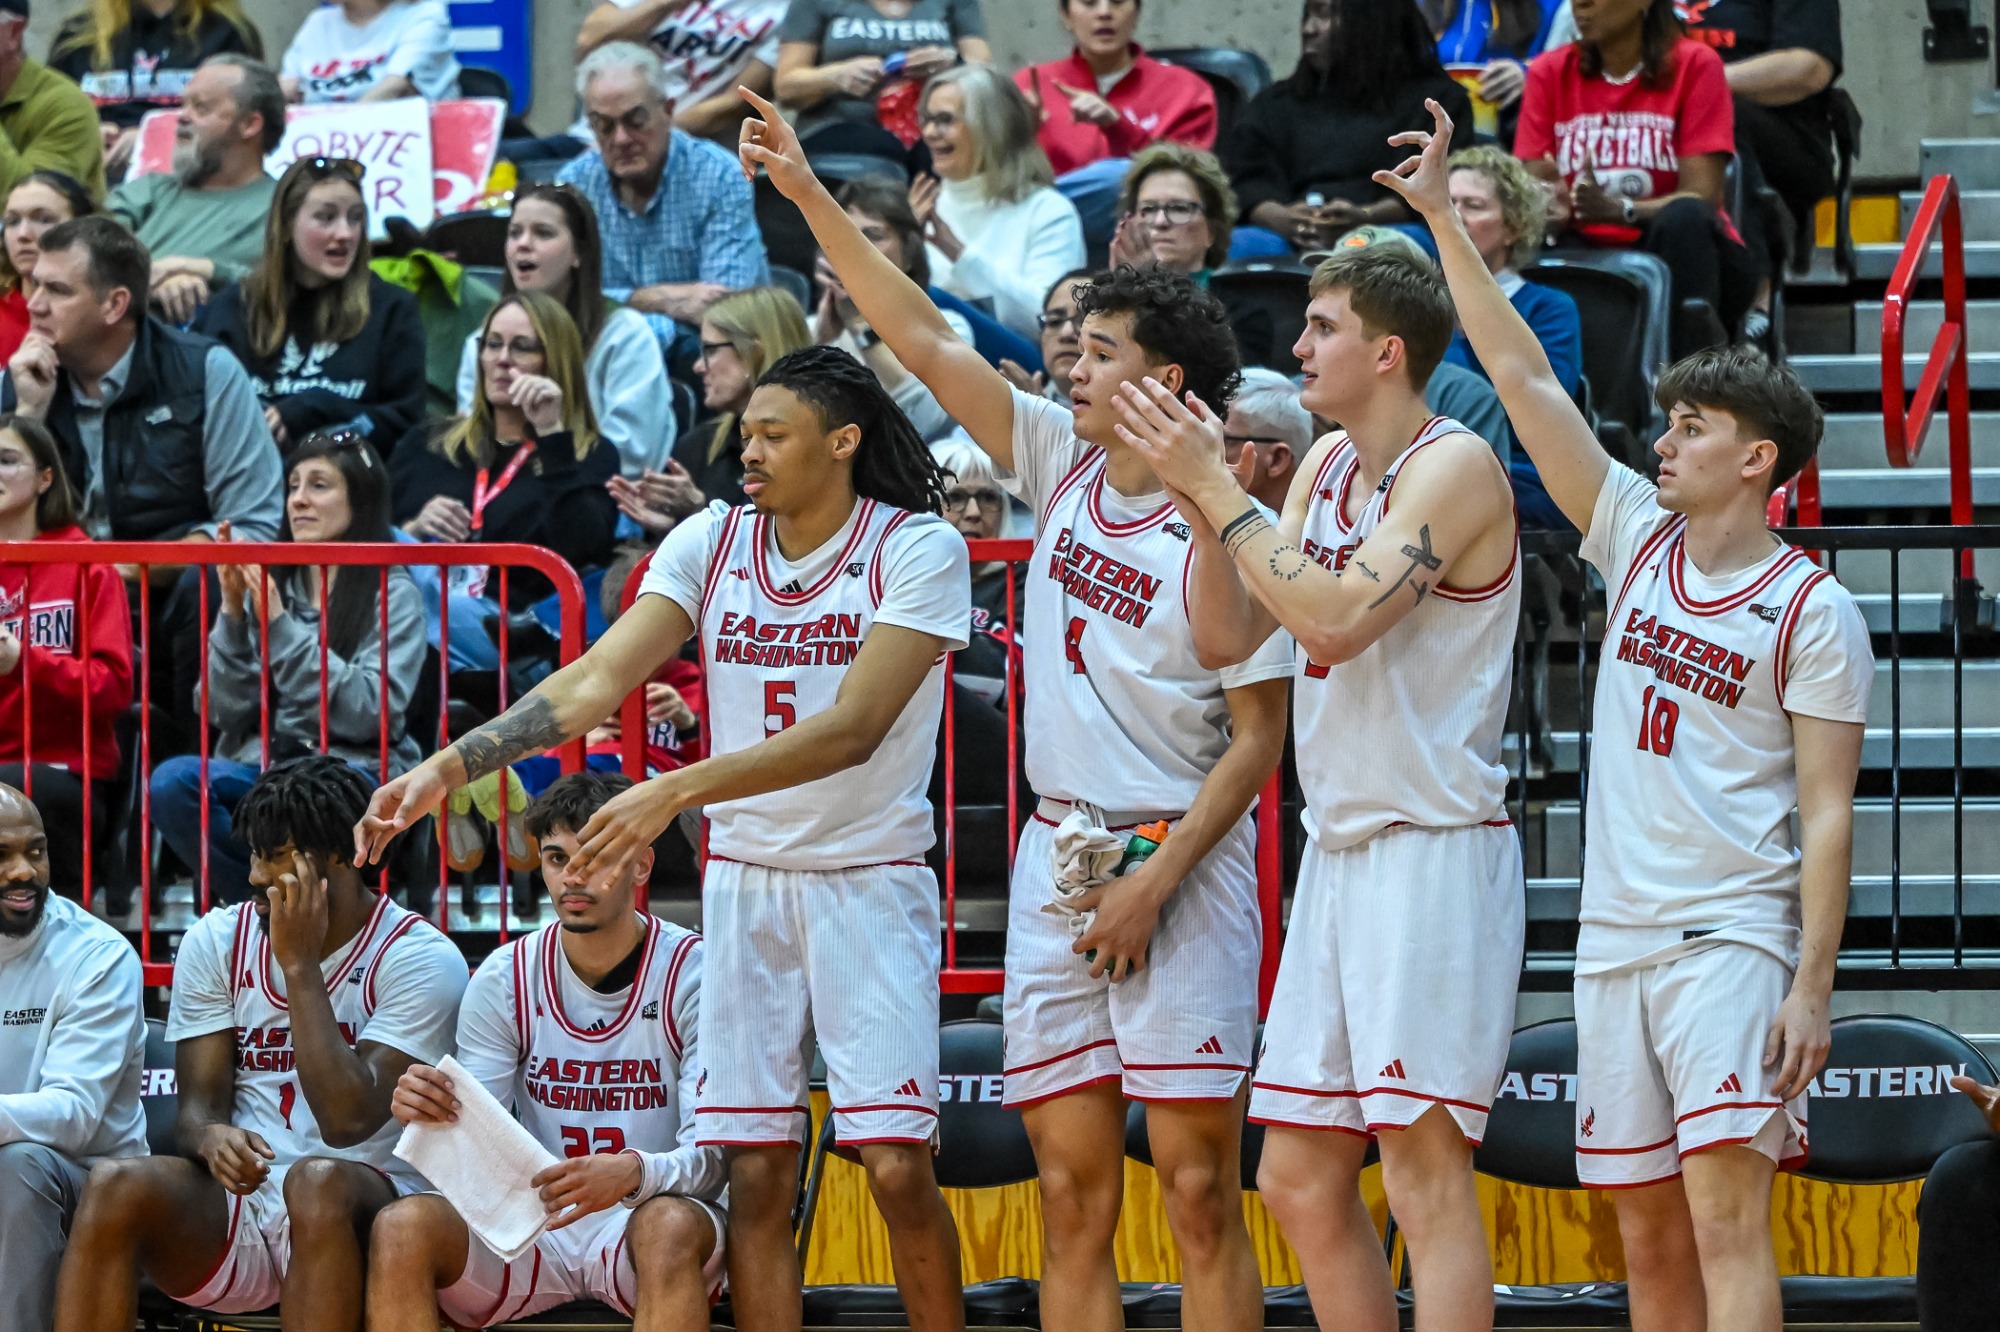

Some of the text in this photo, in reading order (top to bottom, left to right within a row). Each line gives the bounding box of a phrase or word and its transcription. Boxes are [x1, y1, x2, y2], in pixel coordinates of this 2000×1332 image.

[830, 18, 948, 41] EASTERN
[718, 611, 863, 644] EASTERN
[1065, 616, 1088, 675] 4
[1624, 607, 1757, 683] EASTERN
[715, 638, 864, 669] WASHINGTON
[764, 680, 797, 740] 5
[1636, 684, 1680, 759] 10
[528, 1056, 662, 1085] EASTERN
[279, 1081, 296, 1130] 1
[526, 1078, 668, 1112] WASHINGTON
